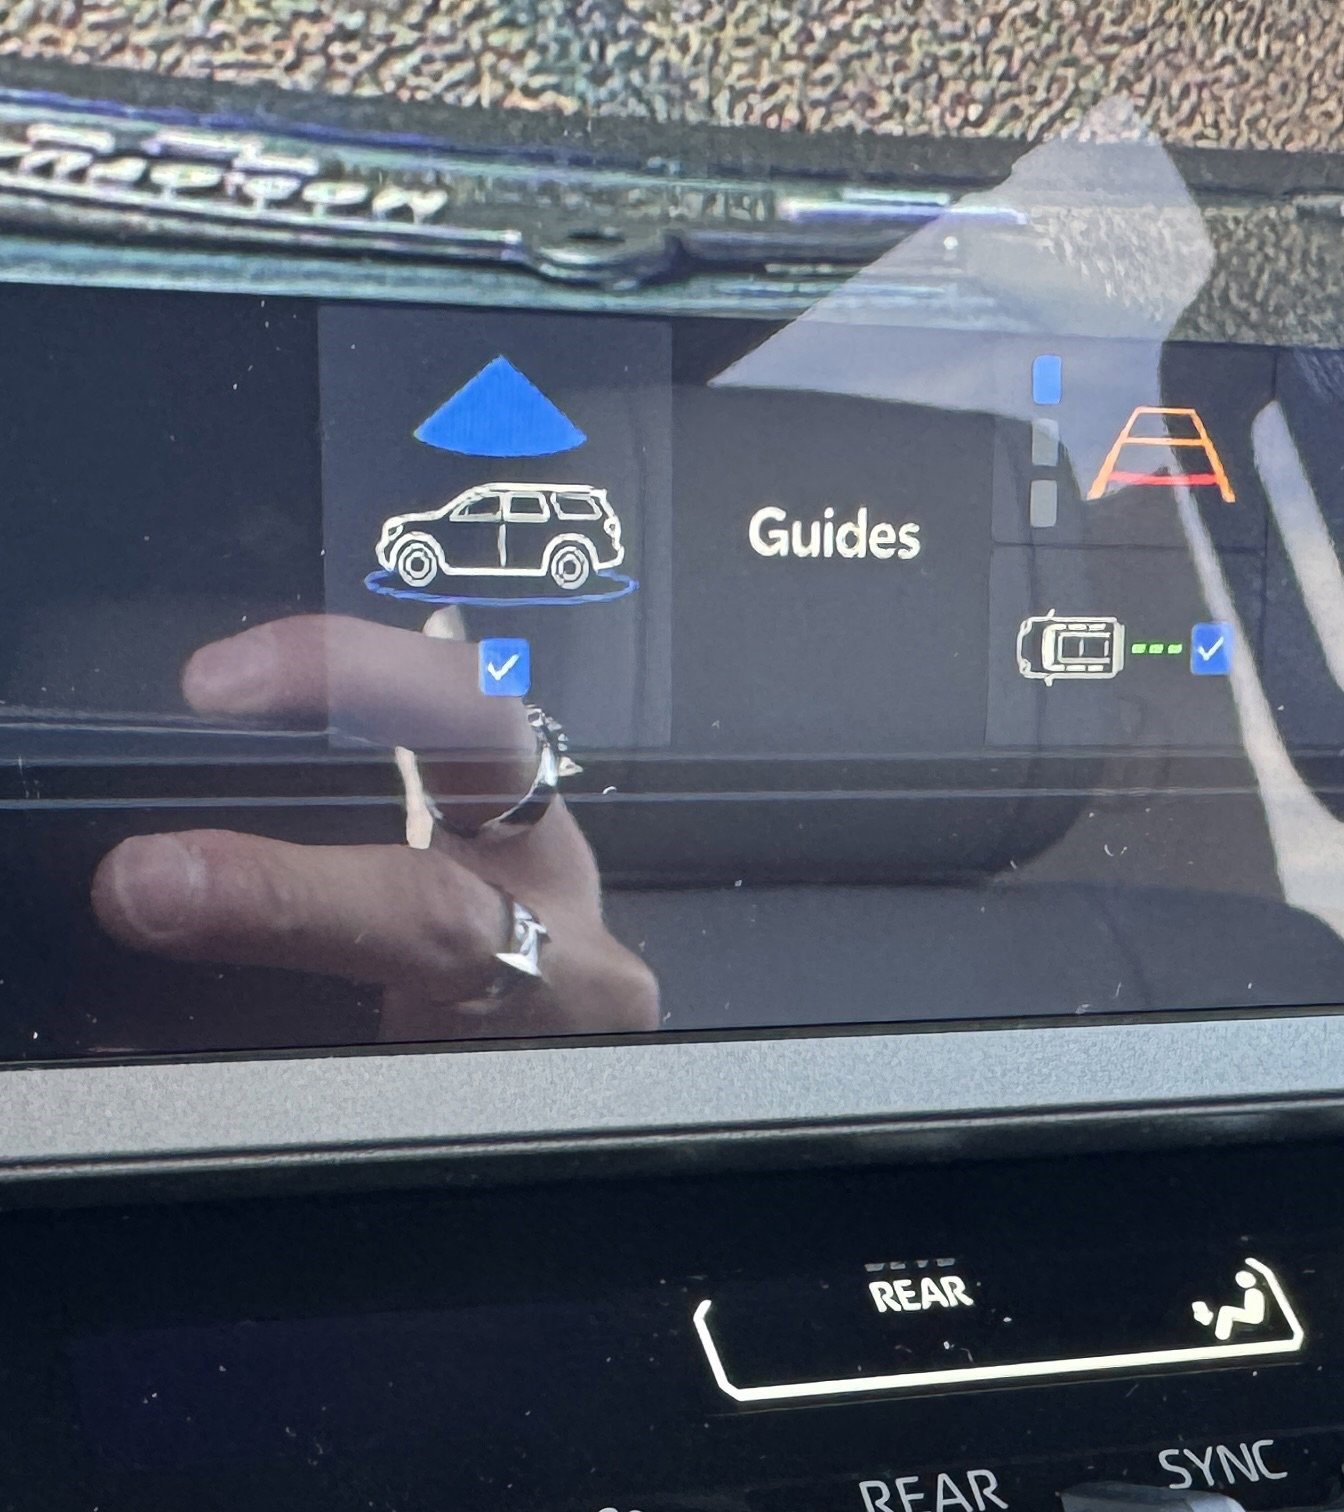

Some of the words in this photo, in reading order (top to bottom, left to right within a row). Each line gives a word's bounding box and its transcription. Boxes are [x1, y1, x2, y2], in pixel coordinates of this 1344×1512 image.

[749, 507, 921, 560] Guides
[869, 1276, 974, 1312] REAR
[1159, 1440, 1288, 1490] SYNC
